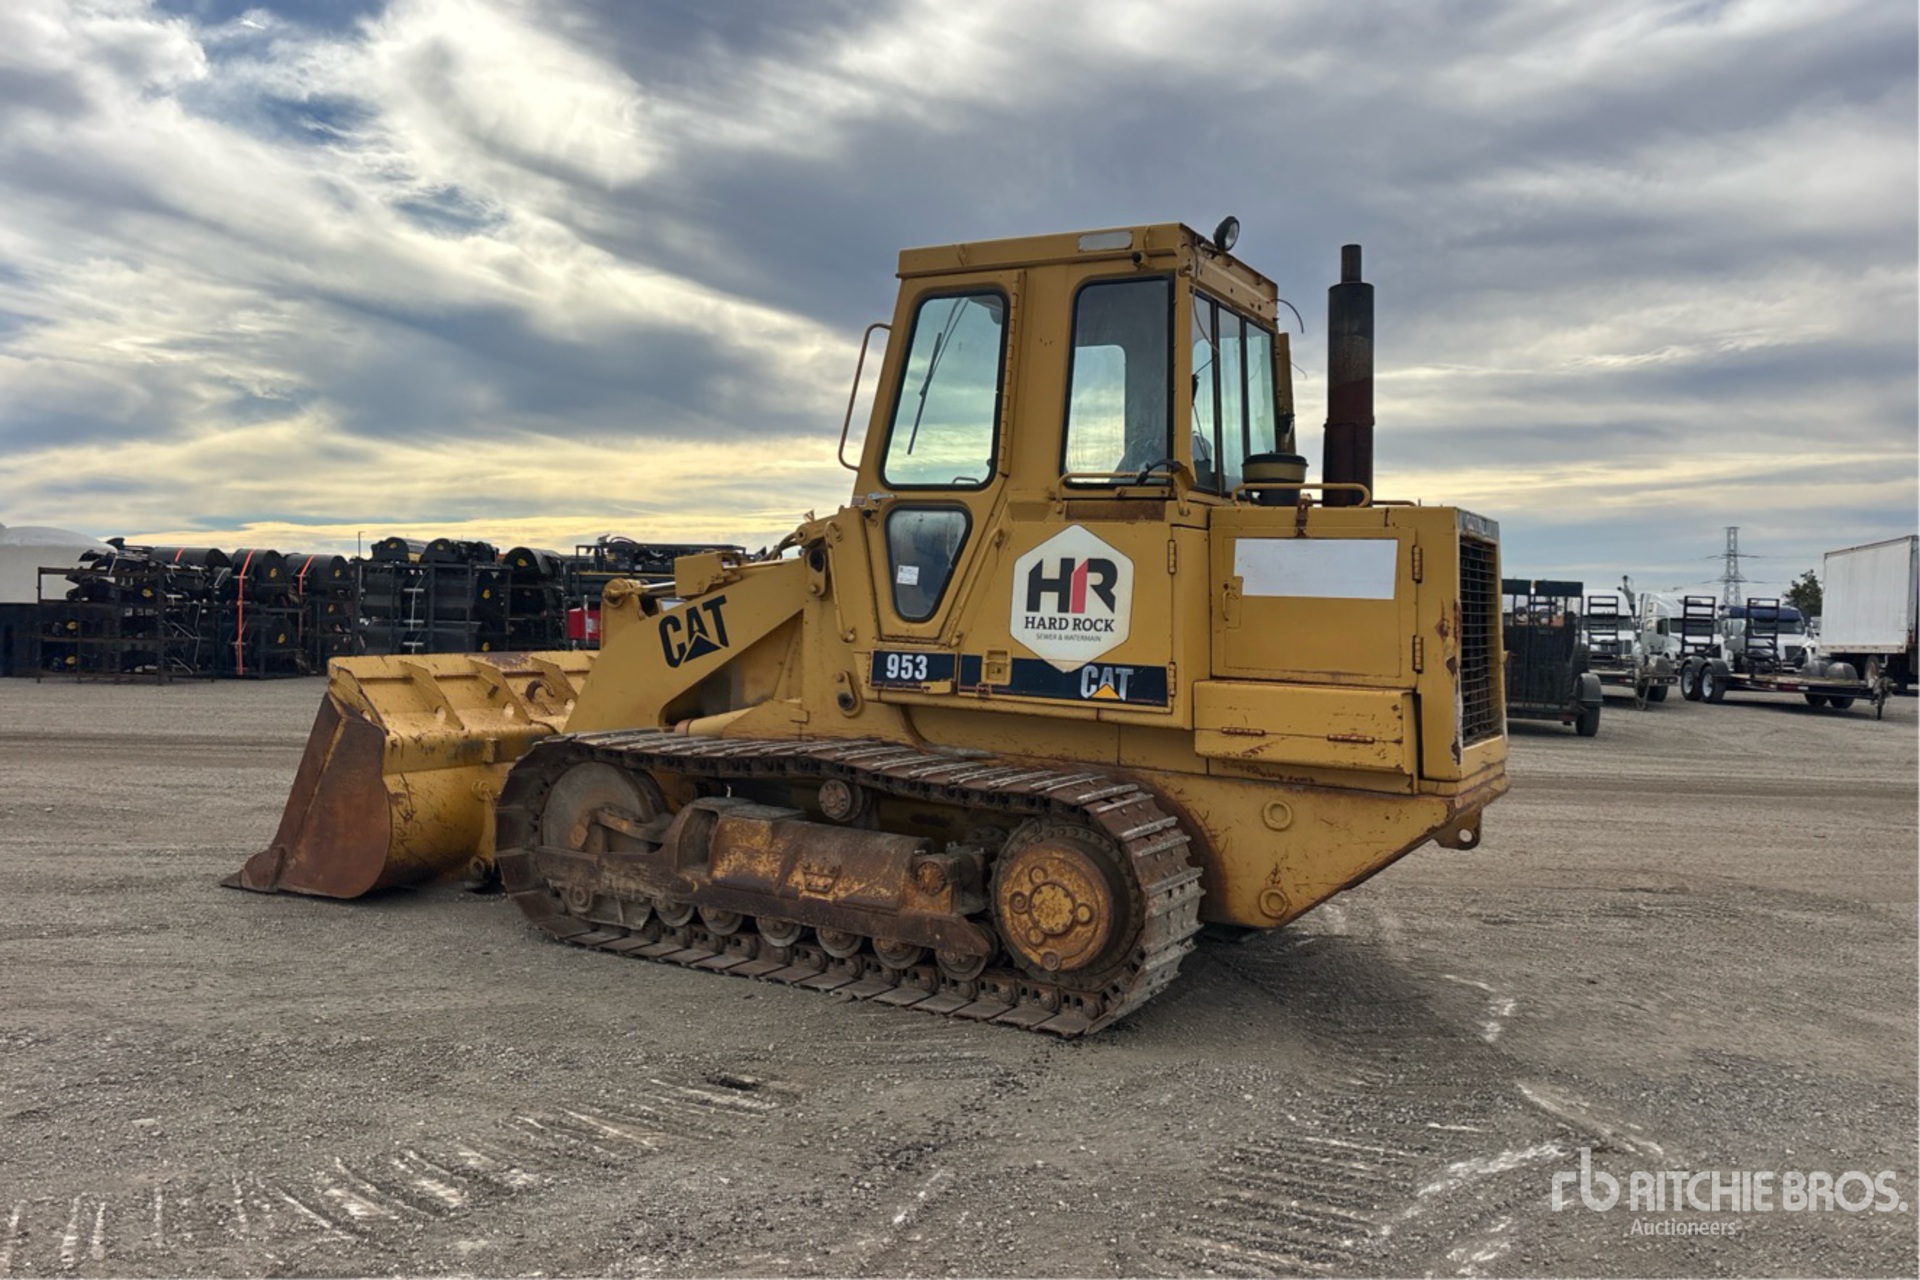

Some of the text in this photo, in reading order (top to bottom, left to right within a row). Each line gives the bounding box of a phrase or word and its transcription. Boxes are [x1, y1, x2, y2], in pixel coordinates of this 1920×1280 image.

[658, 594, 729, 668] CAT
[1024, 616, 1115, 632] HARD ROCK
[1036, 633, 1056, 641] SEWER
[1064, 634, 1101, 642] WATERMAIN
[886, 653, 928, 680] 953
[1080, 665, 1134, 701] CAT
